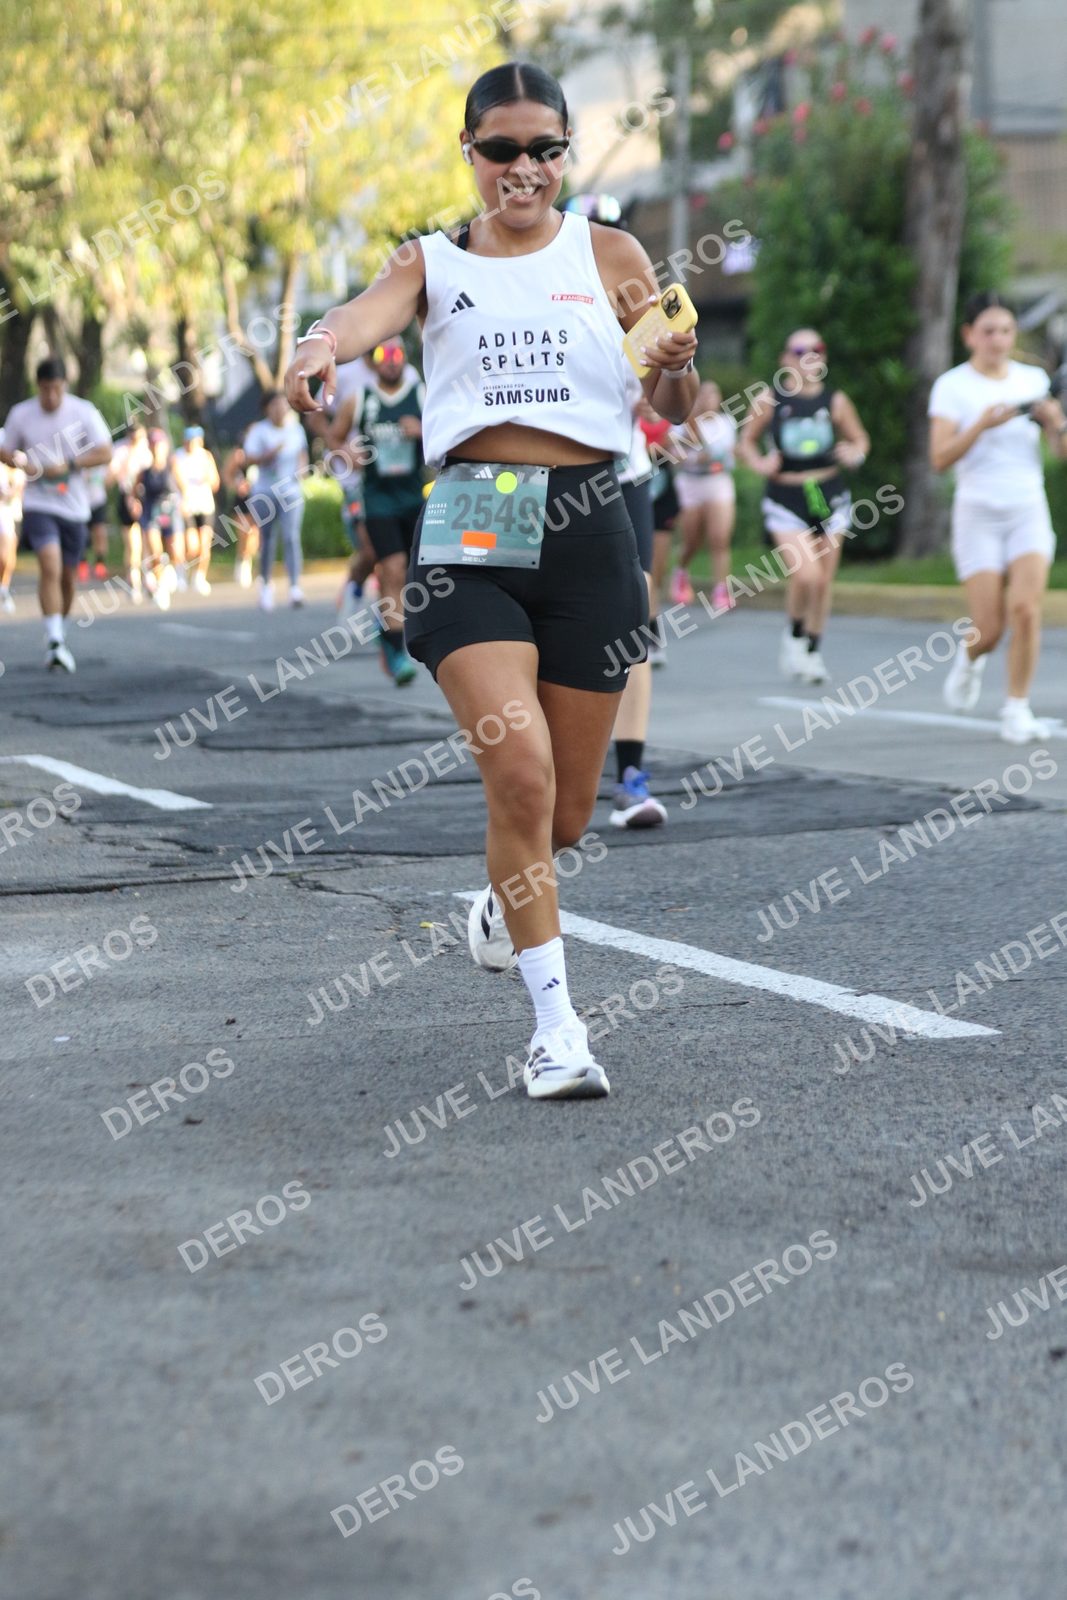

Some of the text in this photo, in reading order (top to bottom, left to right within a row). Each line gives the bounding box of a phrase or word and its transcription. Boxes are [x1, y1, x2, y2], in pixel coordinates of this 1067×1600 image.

[478, 329, 568, 350] ADIDAS
[482, 351, 565, 371] SPLITS
[484, 387, 570, 406] SAMSUNG
[451, 493, 540, 534] 2549
